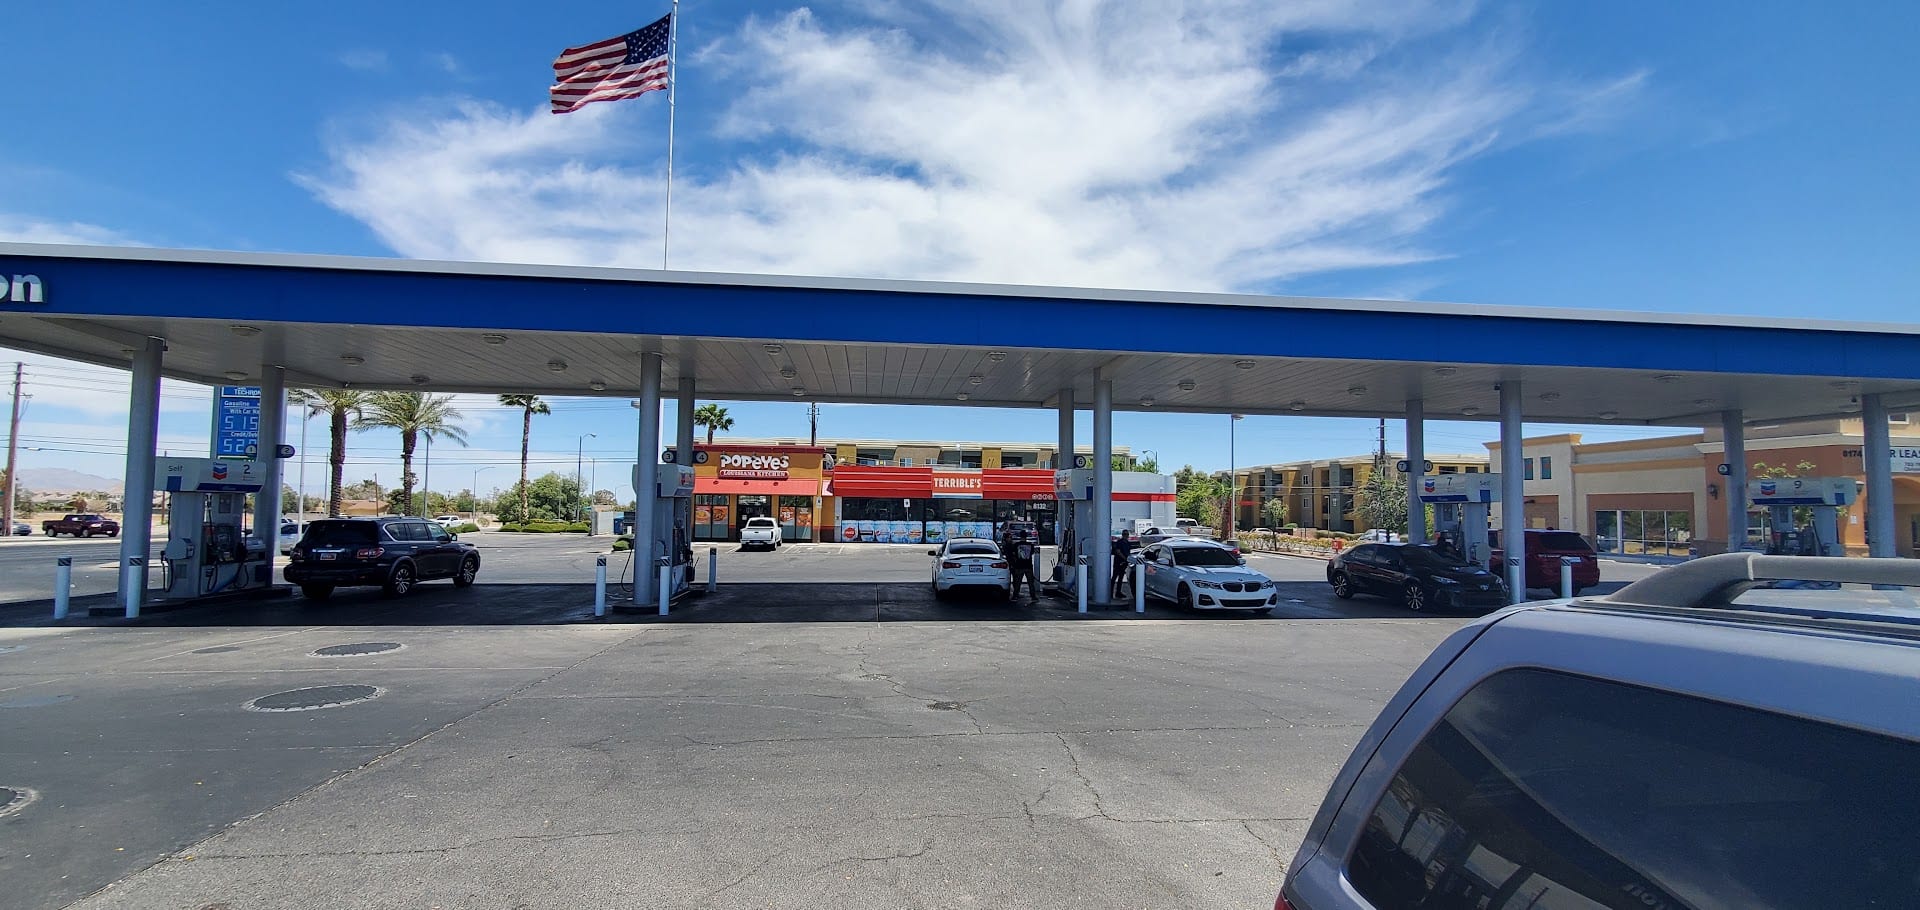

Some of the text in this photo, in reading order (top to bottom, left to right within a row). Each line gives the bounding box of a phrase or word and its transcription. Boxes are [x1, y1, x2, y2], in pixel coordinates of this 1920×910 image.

[167, 464, 184, 472] Self
[243, 464, 251, 475] 2
[933, 477, 982, 489] TERRIBLE'S
[1446, 477, 1453, 486] 7
[1794, 480, 1802, 489] 9
